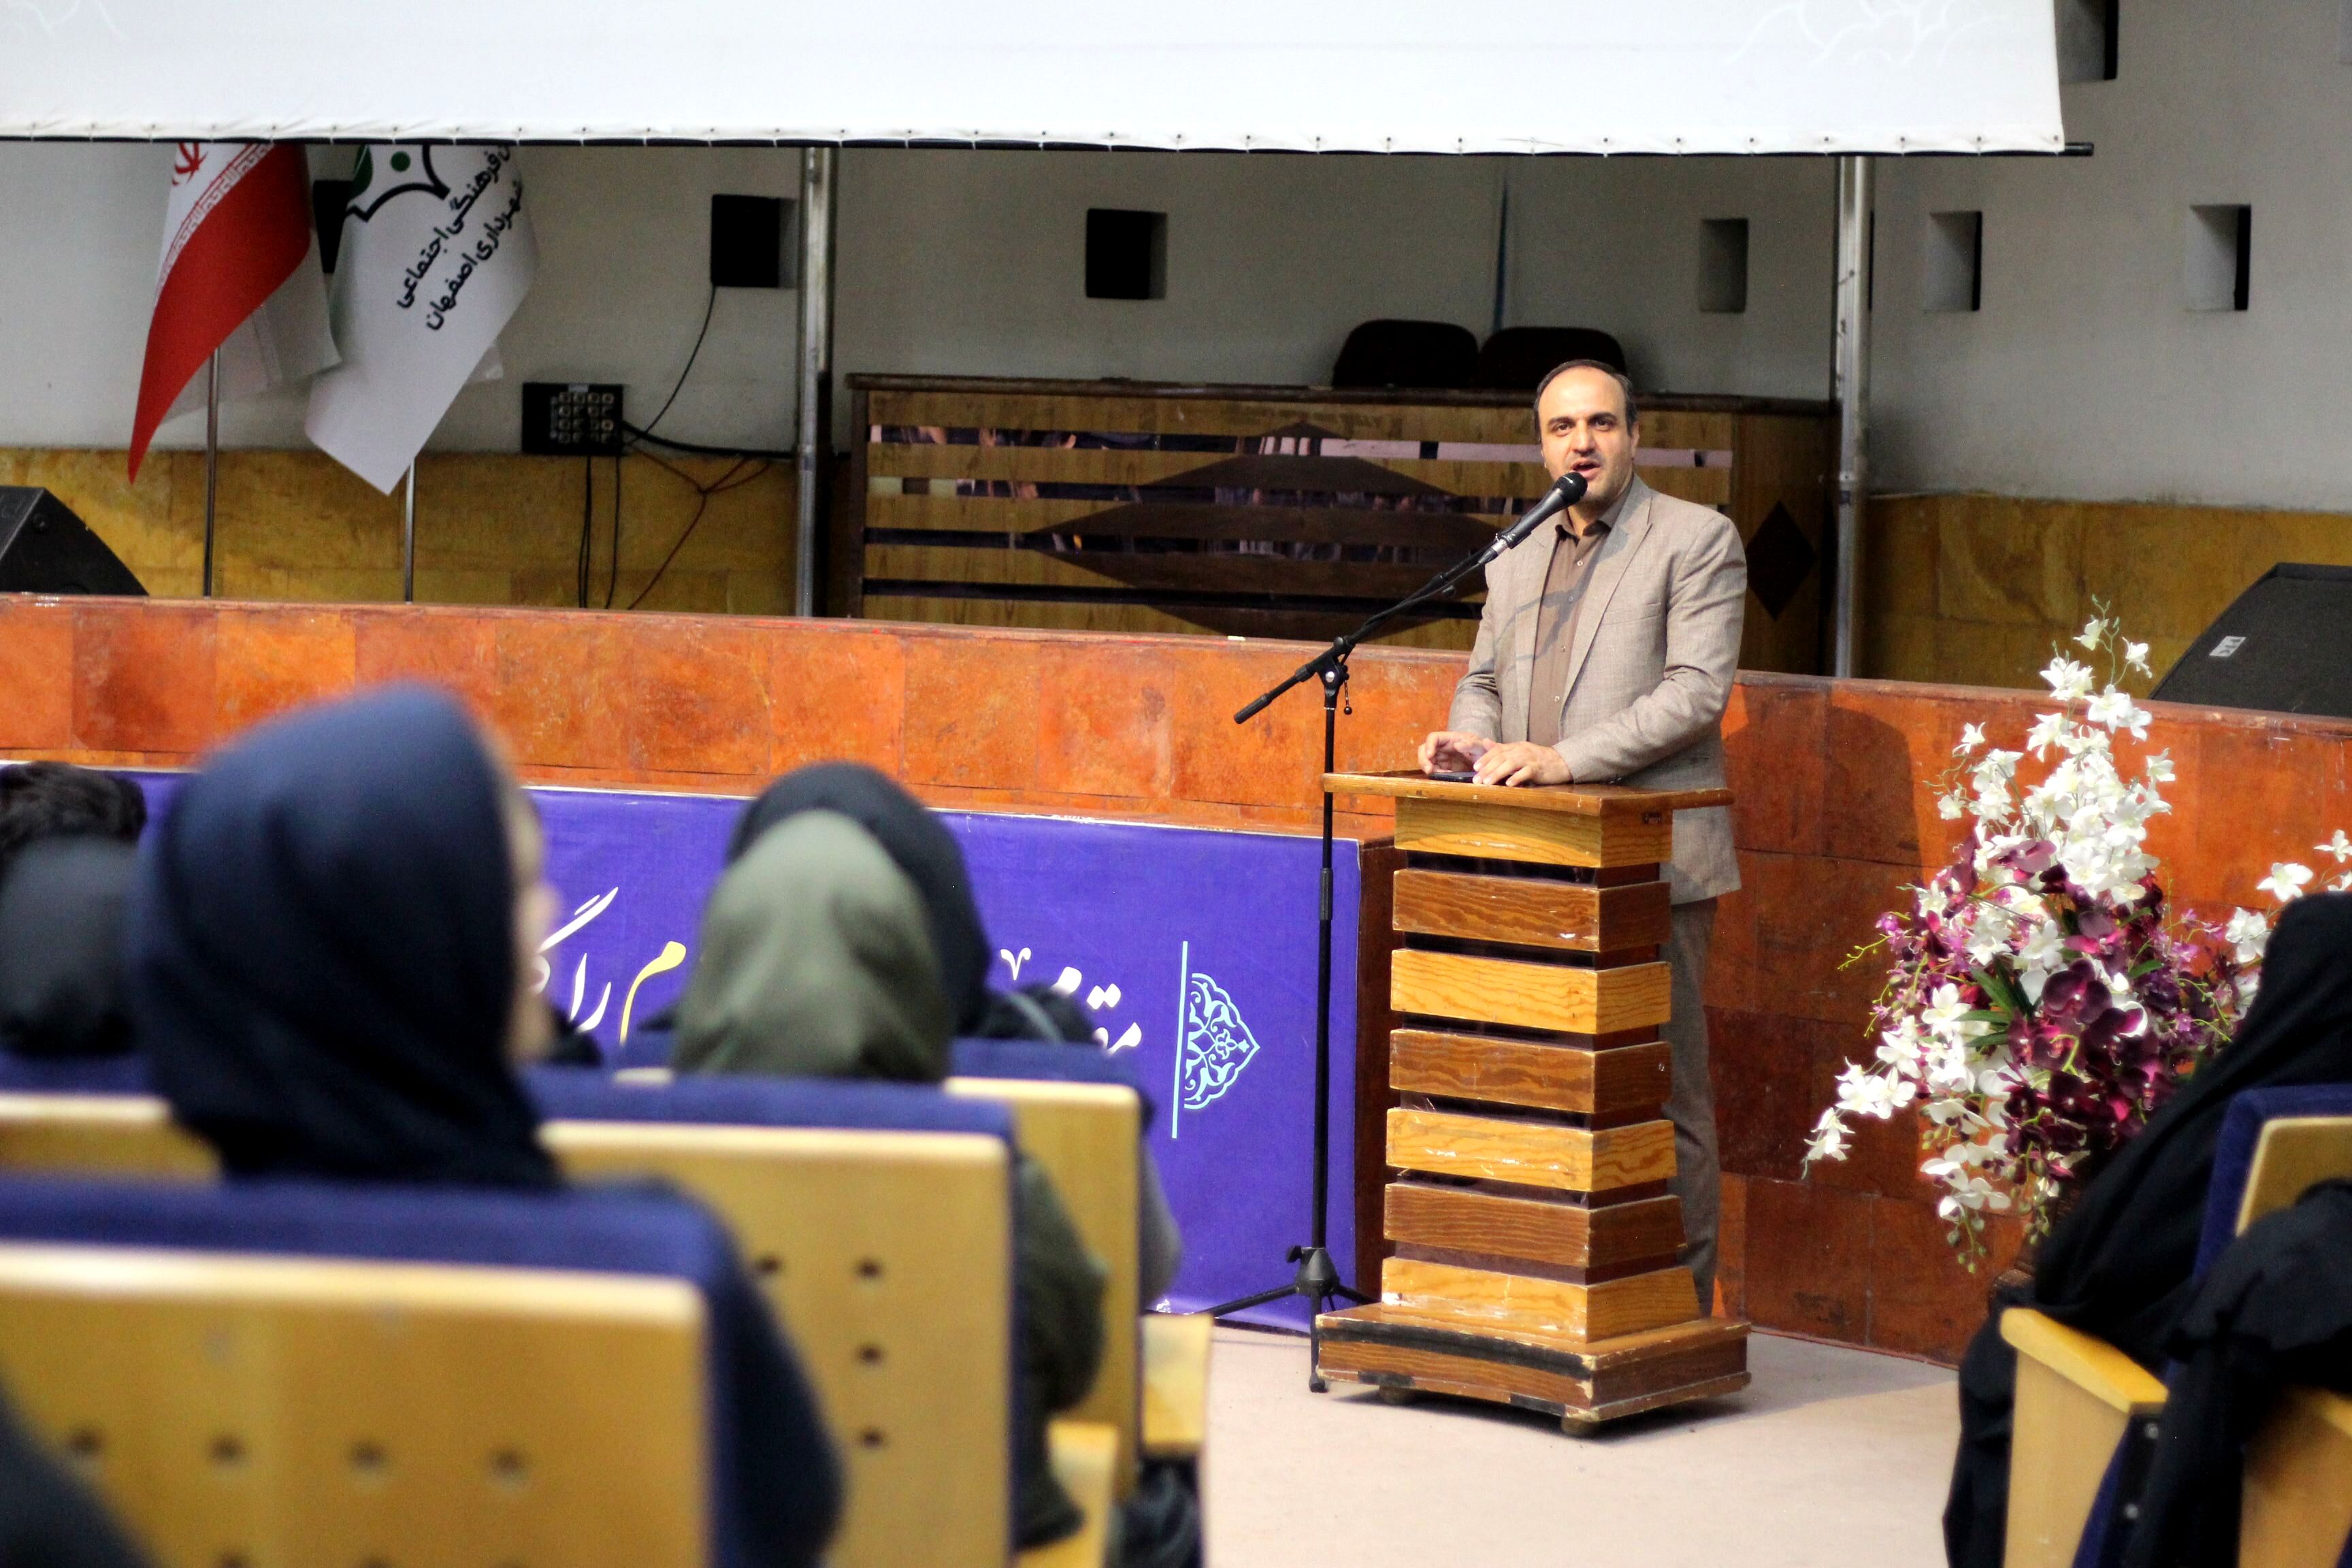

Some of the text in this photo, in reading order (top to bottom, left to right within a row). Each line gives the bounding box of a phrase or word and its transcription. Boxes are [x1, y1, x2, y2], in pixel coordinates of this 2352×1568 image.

[397, 147, 502, 308] فرهنگی اجتماعی
[426, 252, 478, 331] اصفهان
